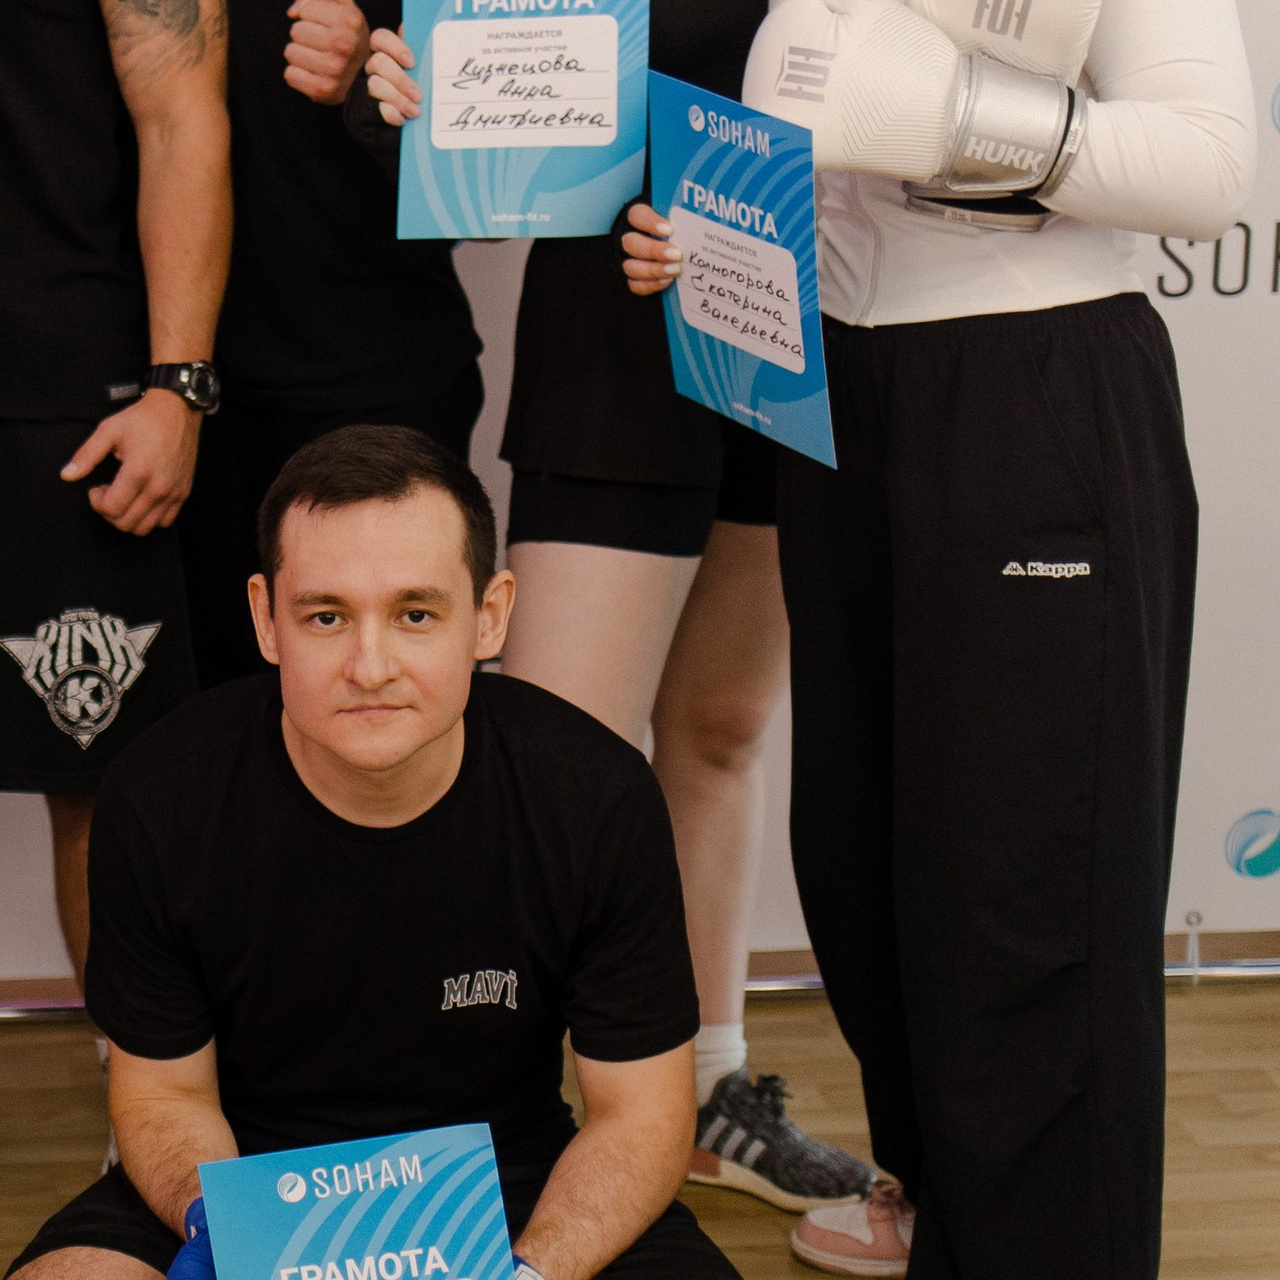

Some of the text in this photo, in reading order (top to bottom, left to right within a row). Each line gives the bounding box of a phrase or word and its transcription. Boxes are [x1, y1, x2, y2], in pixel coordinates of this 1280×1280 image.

[486, 29, 563, 40] НАГРАЖДАЕТСЯ
[707, 110, 771, 159] SOHAM
[965, 136, 1045, 174] HUKK
[681, 179, 778, 239] ГРАМОТА
[704, 232, 758, 258] НАГРАЖДАЕТСЯ
[1028, 562, 1090, 578] Kappa
[311, 1154, 424, 1199] SOHAM
